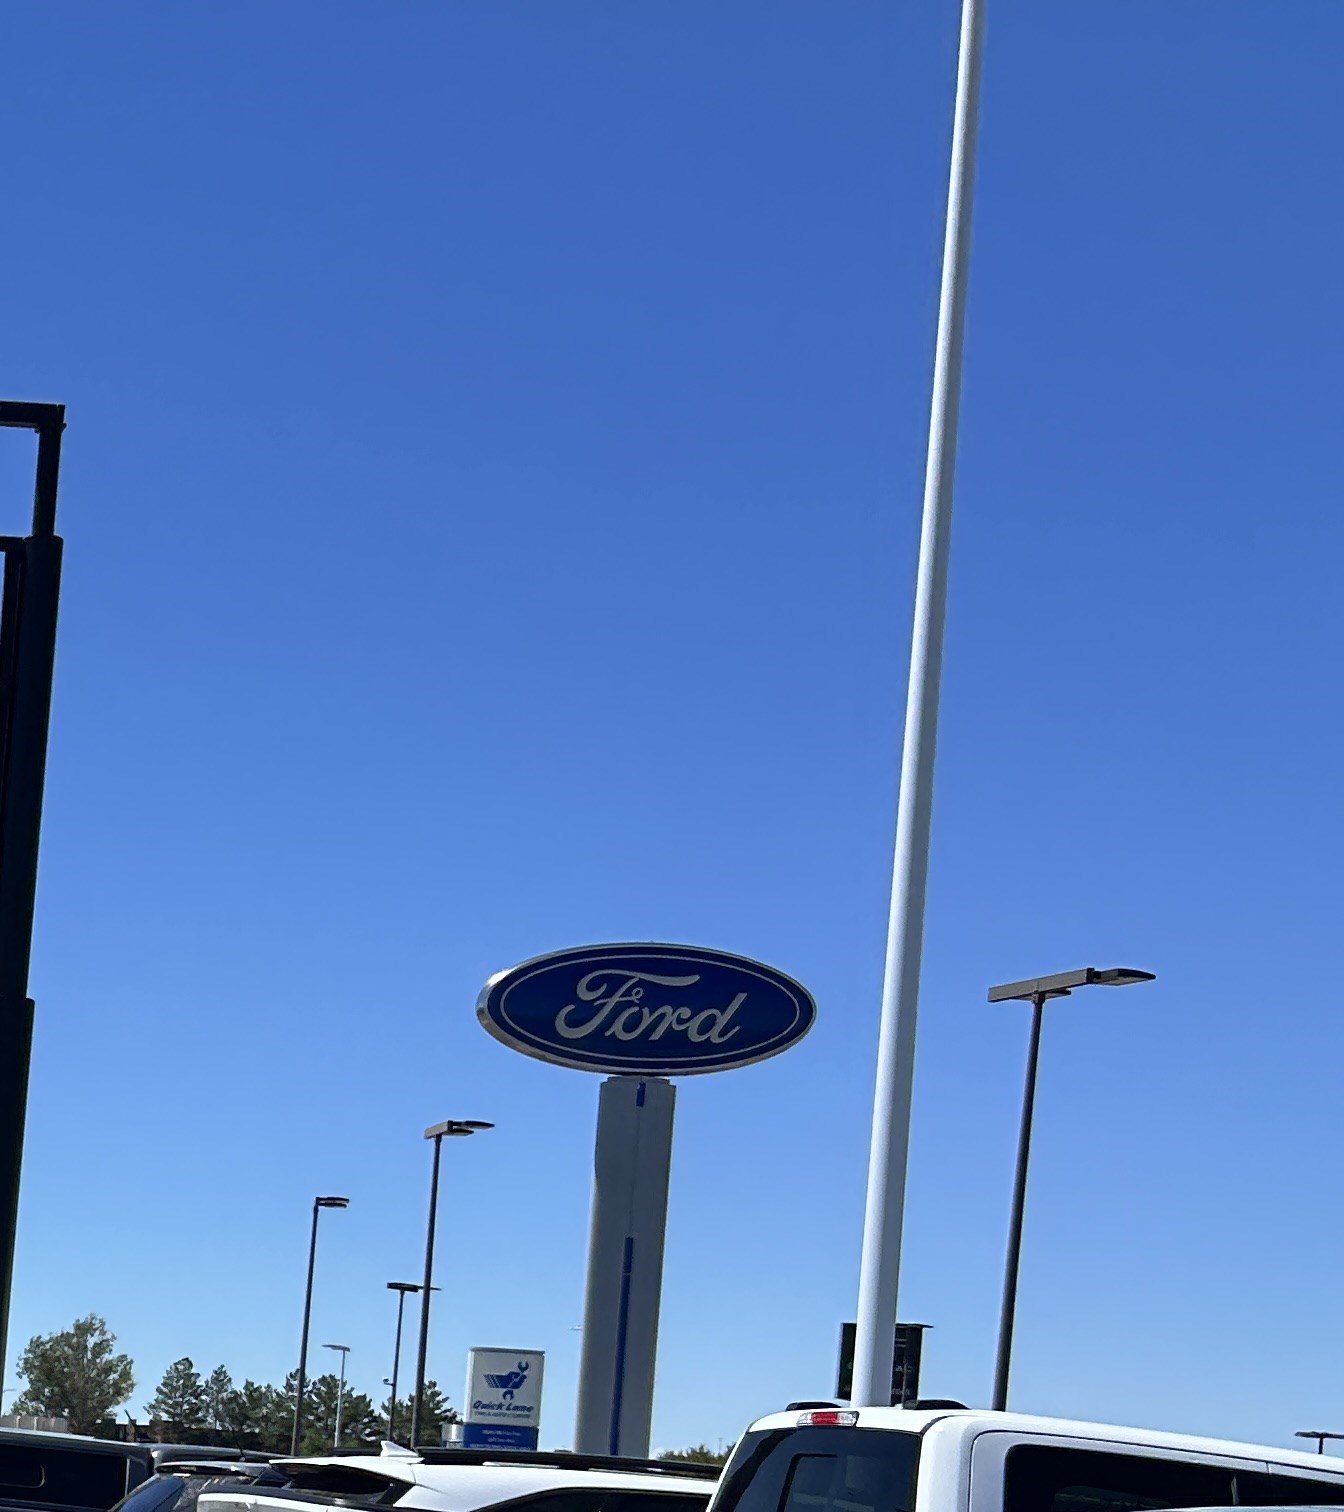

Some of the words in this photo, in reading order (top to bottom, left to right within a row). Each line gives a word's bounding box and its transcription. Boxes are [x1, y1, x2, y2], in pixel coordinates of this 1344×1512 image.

[555, 968, 748, 1044] Ford
[473, 1400, 505, 1411] Quick
[505, 1402, 534, 1413] Lane
